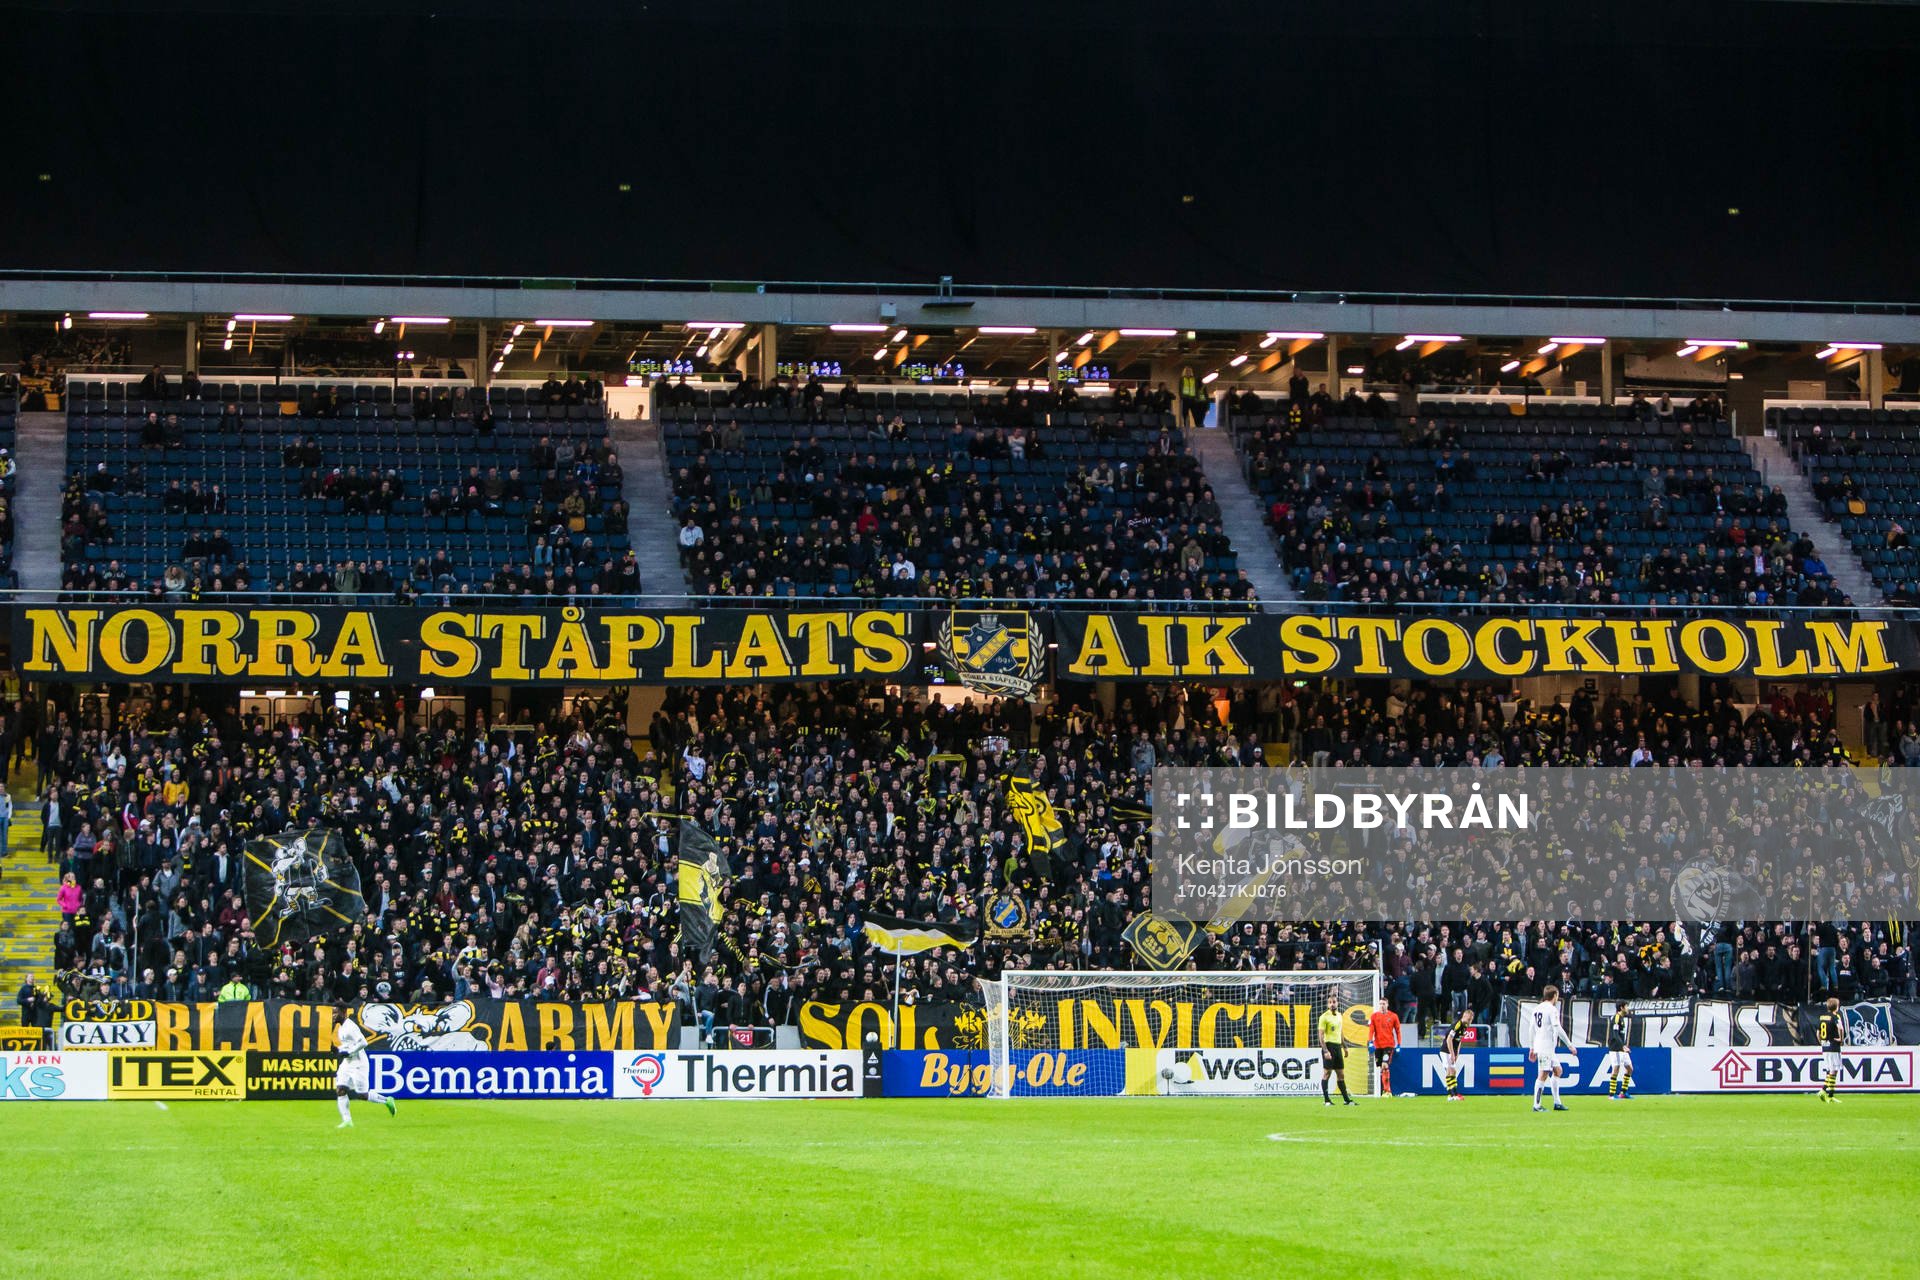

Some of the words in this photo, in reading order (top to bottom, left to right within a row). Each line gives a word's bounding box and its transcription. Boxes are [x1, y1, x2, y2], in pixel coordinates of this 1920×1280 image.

[23, 609, 394, 677] NORRA
[420, 606, 912, 680] STÅPLATS
[1069, 614, 1253, 676] AIK
[1280, 616, 1900, 677] STOCKHOLM
[1628, 999, 1690, 1010] OUNGSTERS
[499, 1001, 678, 1050] ARMY
[1534, 1012, 1543, 1028] 18
[65, 1023, 151, 1045] GARY
[1820, 1022, 1827, 1039] 8
[112, 1056, 236, 1087] ITEX
[262, 1058, 338, 1072] MASKIN
[369, 1054, 608, 1095] Bemannia
[622, 1066, 655, 1074] Thermia
[678, 1054, 854, 1092] Thermia
[1203, 1050, 1320, 1081] weber
[194, 1088, 241, 1096] RENTAL
[247, 1076, 337, 1091] UTHYRNI
[1254, 1082, 1320, 1091] SAINT-GOBAIN
